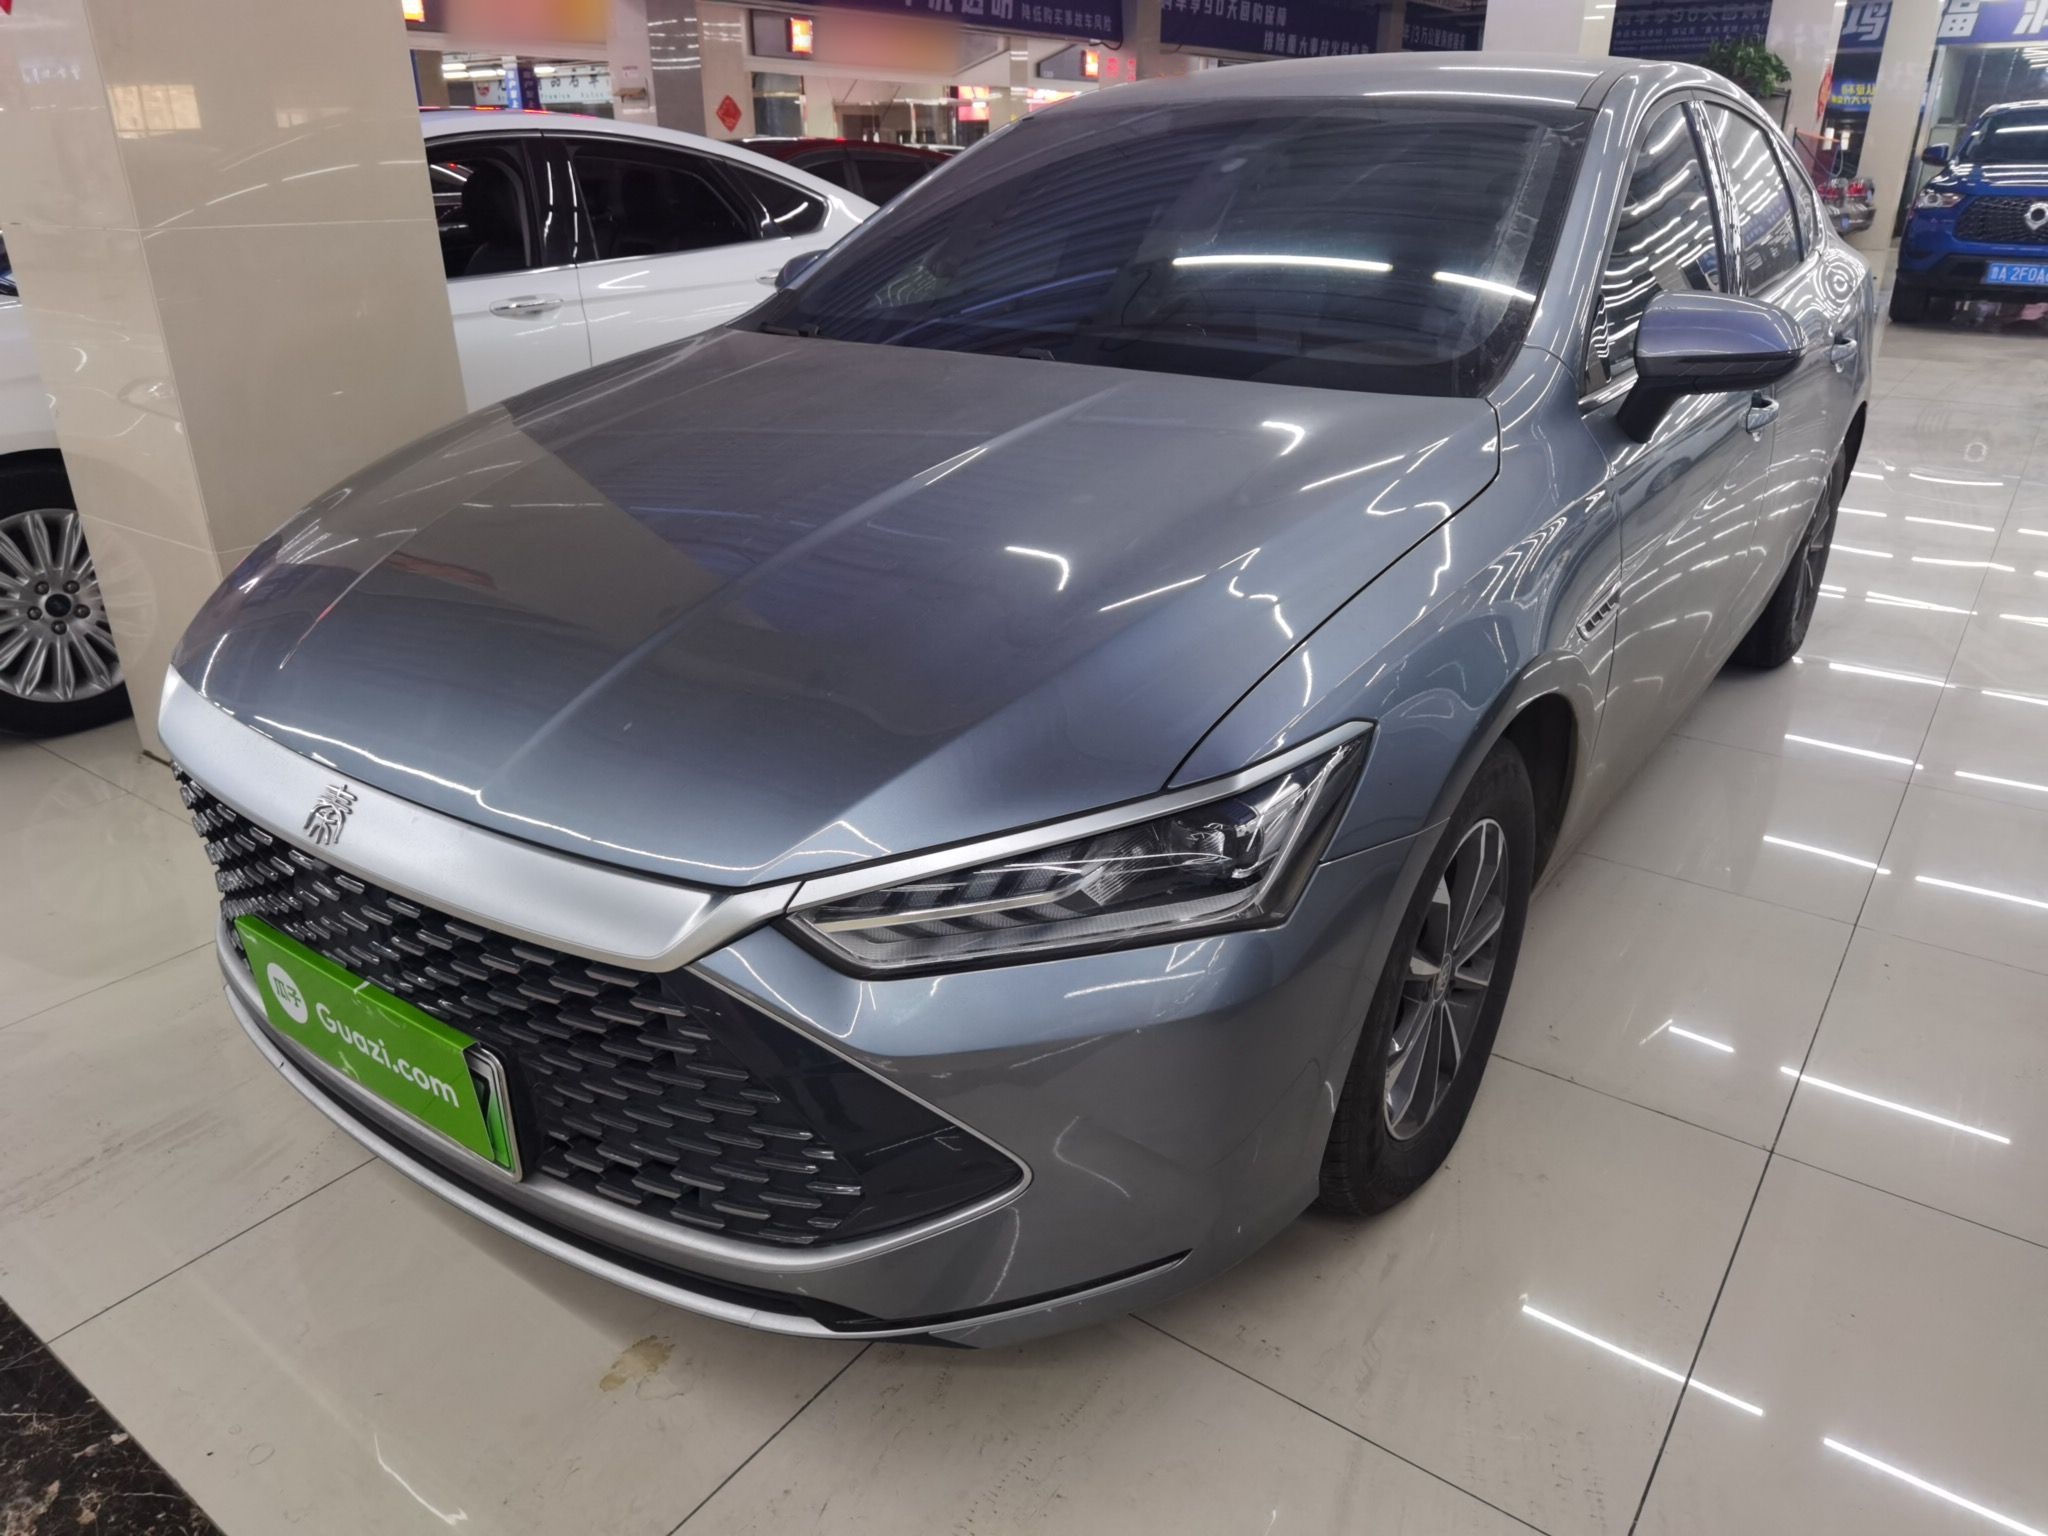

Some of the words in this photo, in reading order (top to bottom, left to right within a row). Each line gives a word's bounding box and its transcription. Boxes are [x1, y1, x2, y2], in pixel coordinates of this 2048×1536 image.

[1021, 3, 1112, 32] 降低购买事故车风险
[273, 976, 302, 1008] 瓜子
[315, 1002, 460, 1108] Guazi.com
